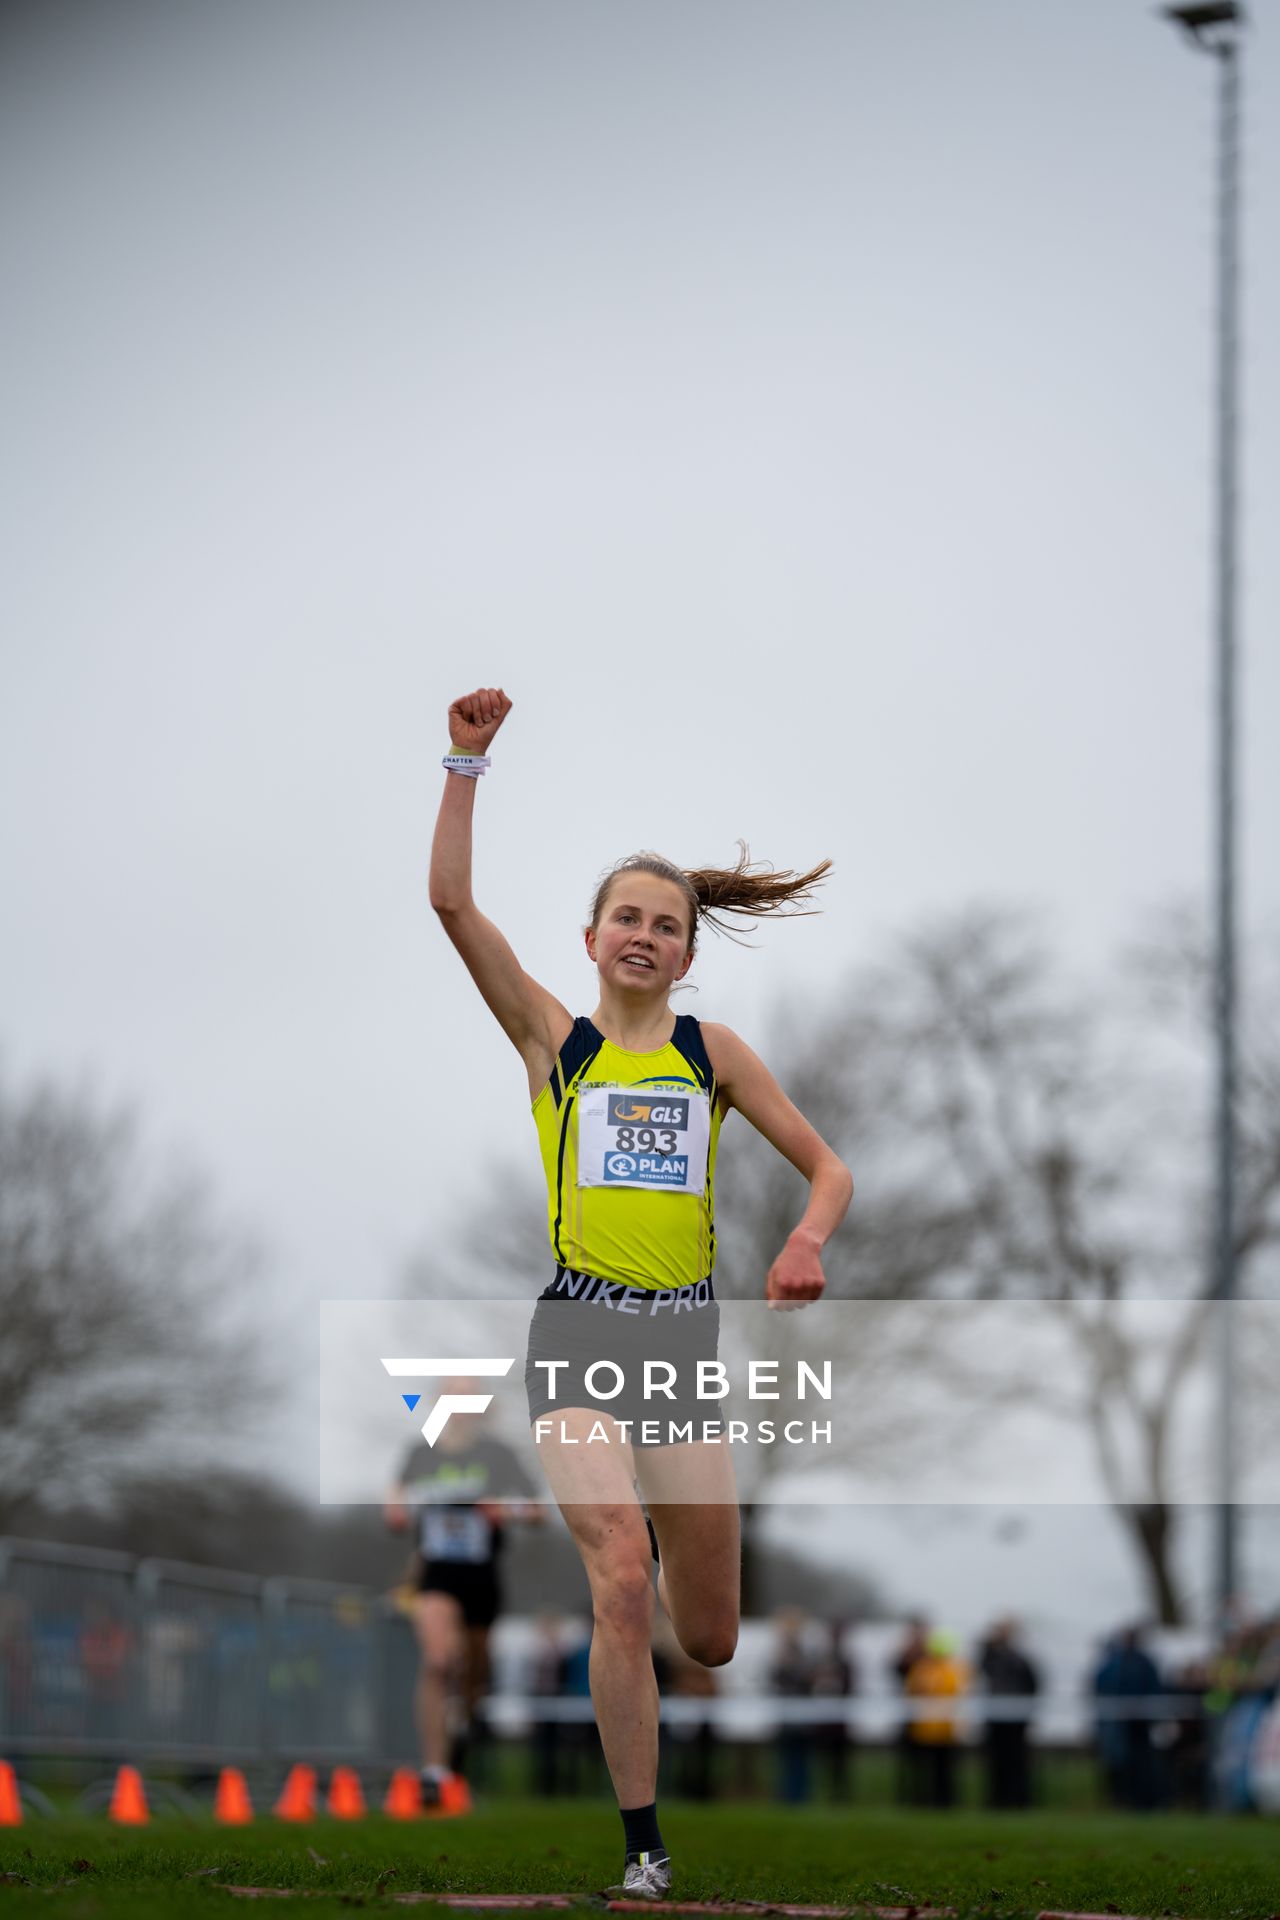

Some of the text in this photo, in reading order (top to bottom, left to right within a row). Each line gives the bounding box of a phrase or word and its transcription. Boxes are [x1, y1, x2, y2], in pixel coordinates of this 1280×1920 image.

[650, 1106, 682, 1124] GLS
[616, 1127, 678, 1155] 893
[639, 1158, 685, 1174] PLAN
[639, 1173, 684, 1182] INTERNATIONAL
[556, 1269, 710, 1317] NIKE PRO
